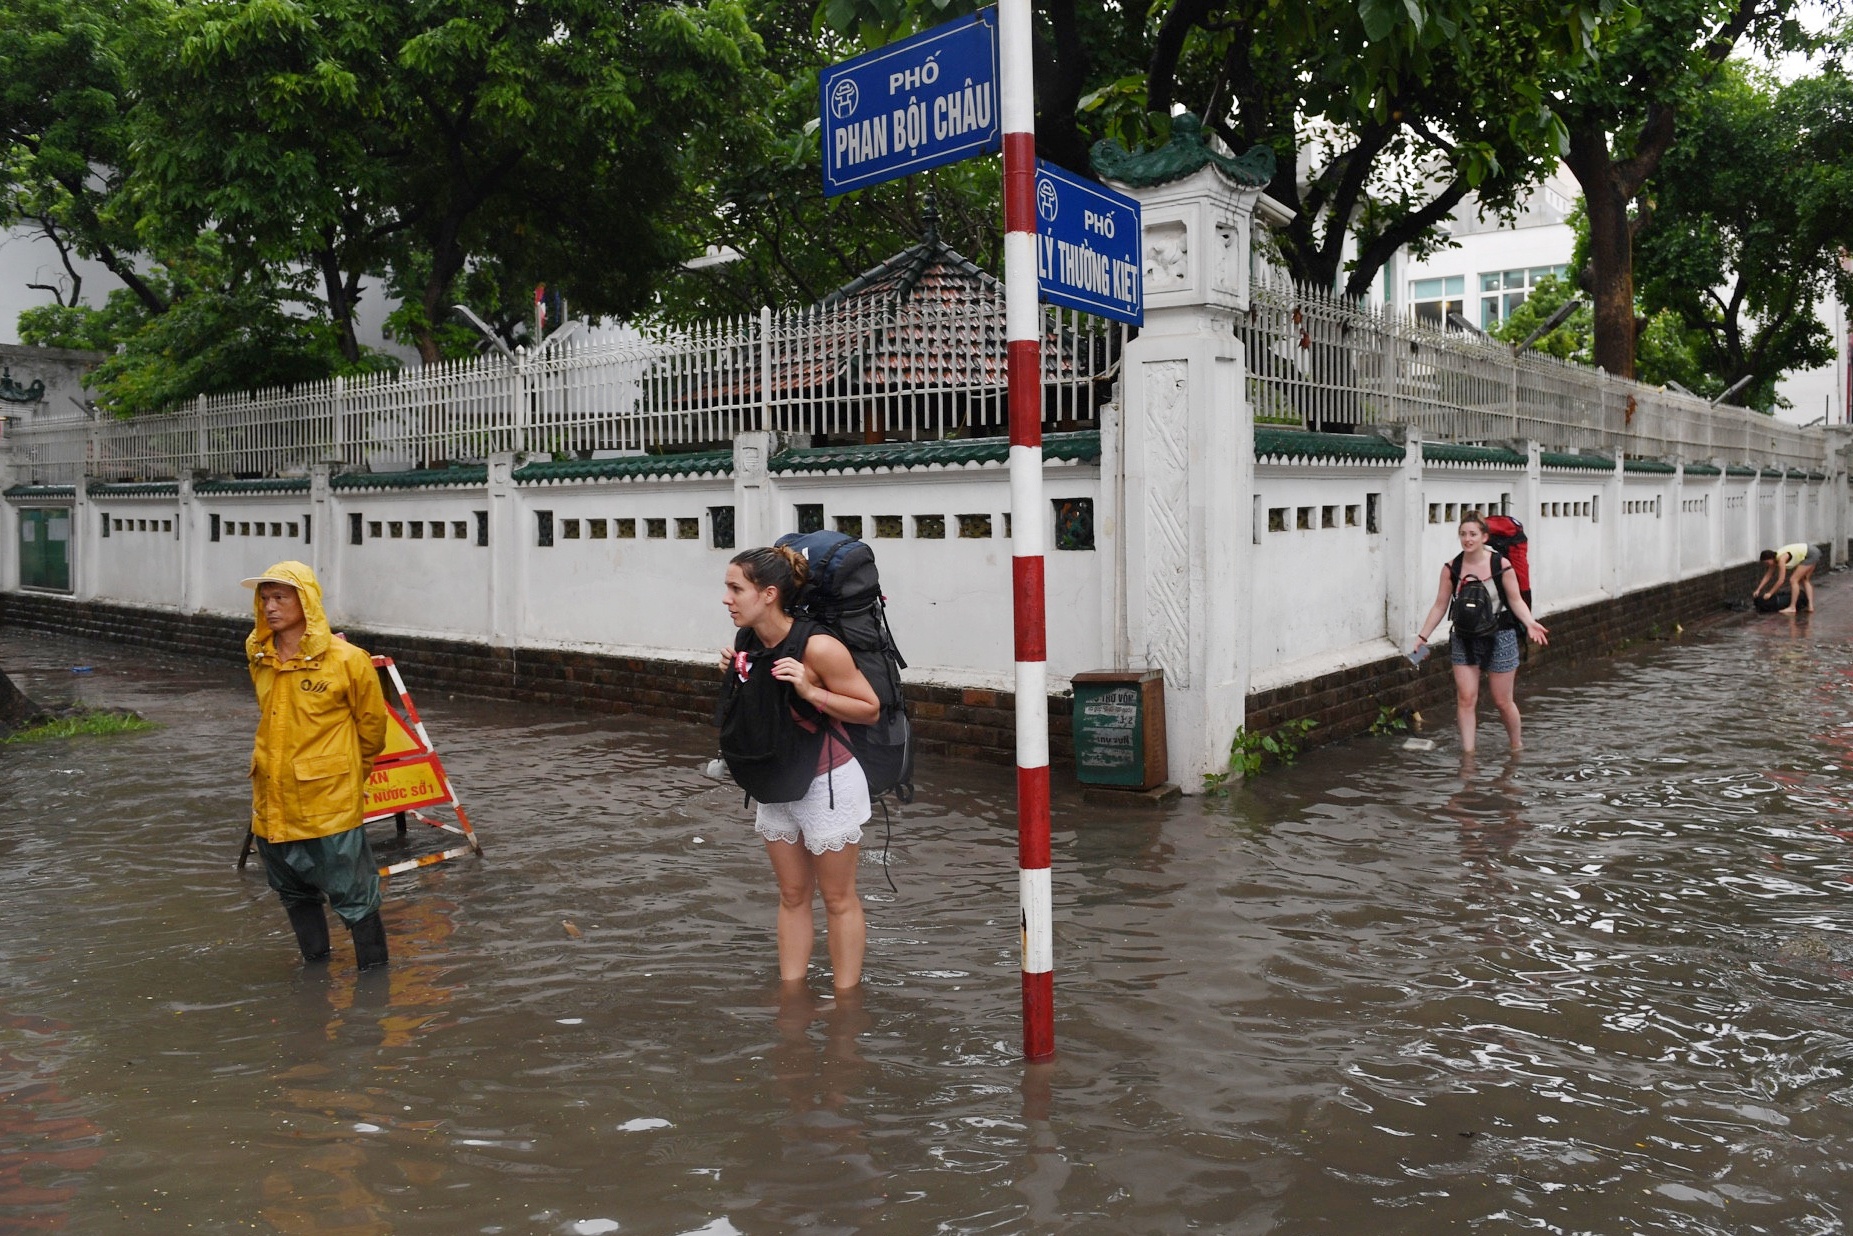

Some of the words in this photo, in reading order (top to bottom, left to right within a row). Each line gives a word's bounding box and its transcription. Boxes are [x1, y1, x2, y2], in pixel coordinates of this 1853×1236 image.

[890, 50, 941, 95] PHỐ
[835, 114, 888, 169] PHAN
[893, 95, 928, 157] BỘI
[933, 77, 991, 141] CHÂU
[1084, 209, 1116, 239] PHỐ
[1037, 227, 1054, 280] LÝ
[1057, 238, 1110, 297] THƯỜNG
[1112, 253, 1138, 312] KIỆT
[369, 771, 389, 786] XN
[427, 783, 435, 794] 1
